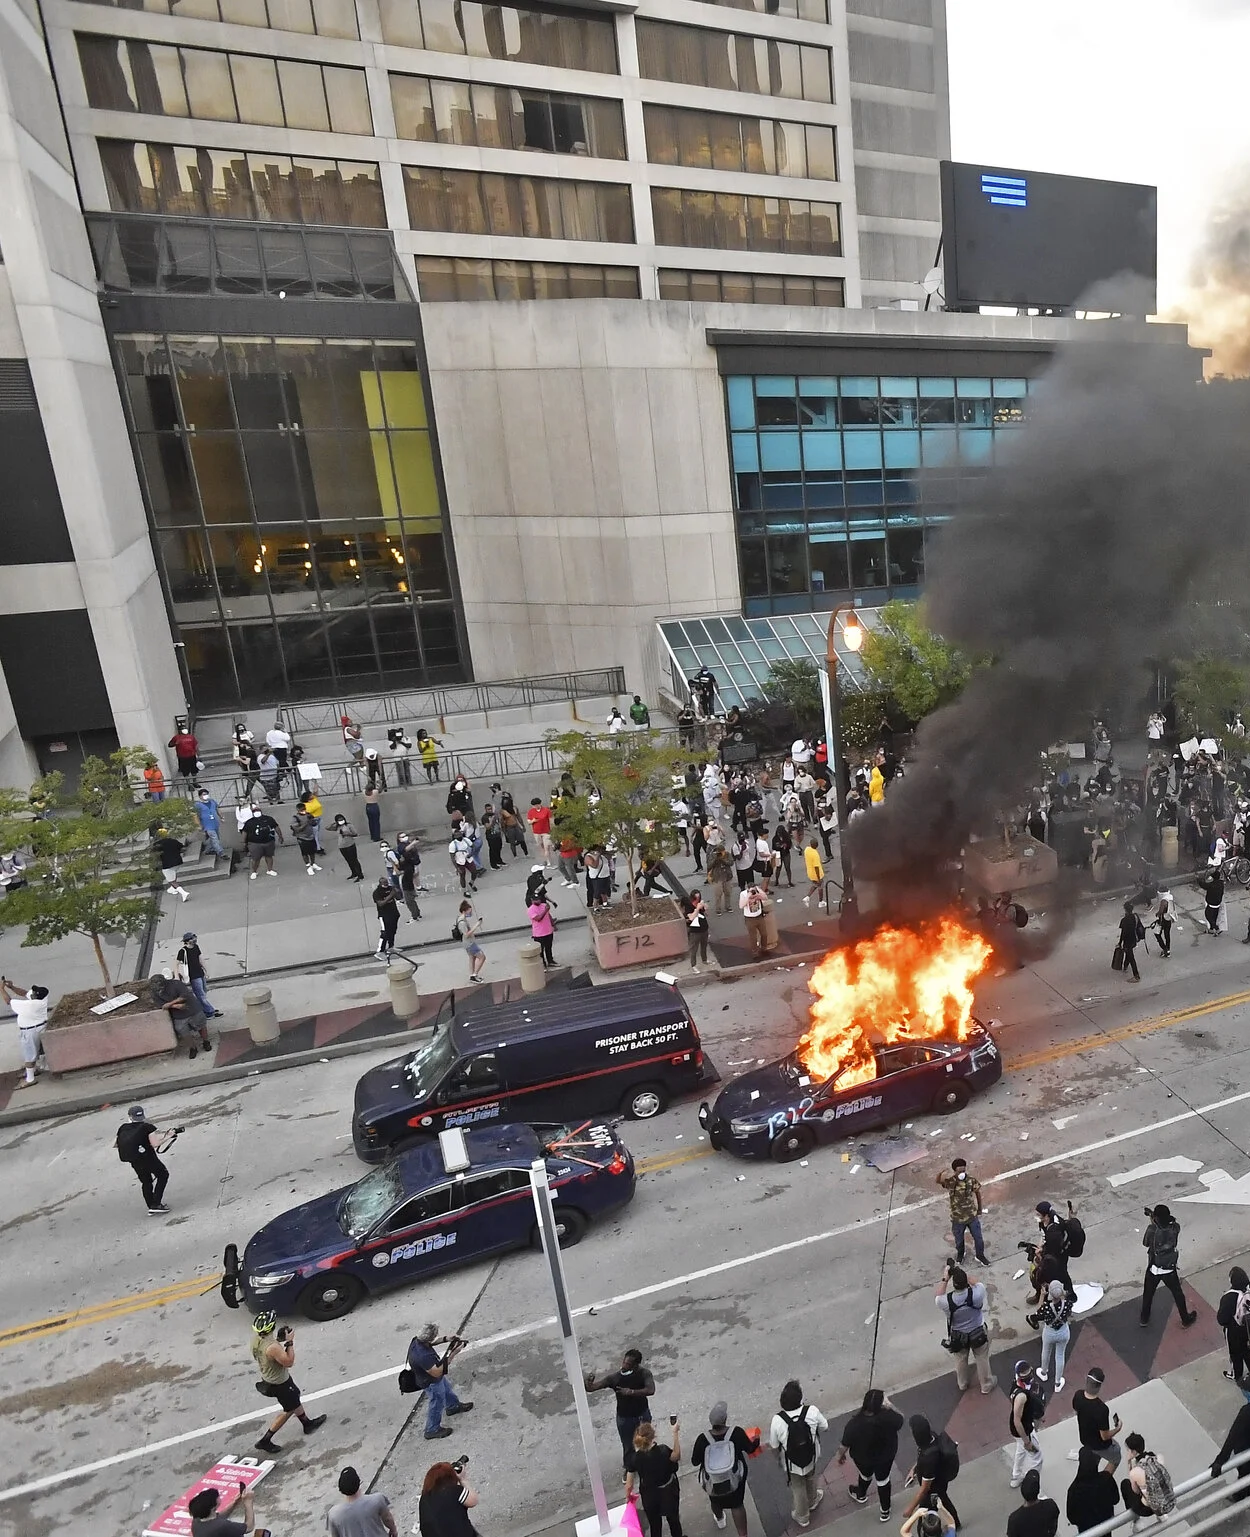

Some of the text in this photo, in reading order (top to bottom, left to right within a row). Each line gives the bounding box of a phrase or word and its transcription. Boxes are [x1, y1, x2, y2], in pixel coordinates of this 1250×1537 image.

[615, 934, 655, 954] F12
[595, 1020, 689, 1048] PRISONER TRANSPORT
[609, 1032, 679, 1054] STAY BACK 50 FT.
[444, 1107, 500, 1129] POLICE
[835, 1096, 883, 1119] POLICE
[390, 1232, 457, 1265] POLICE
